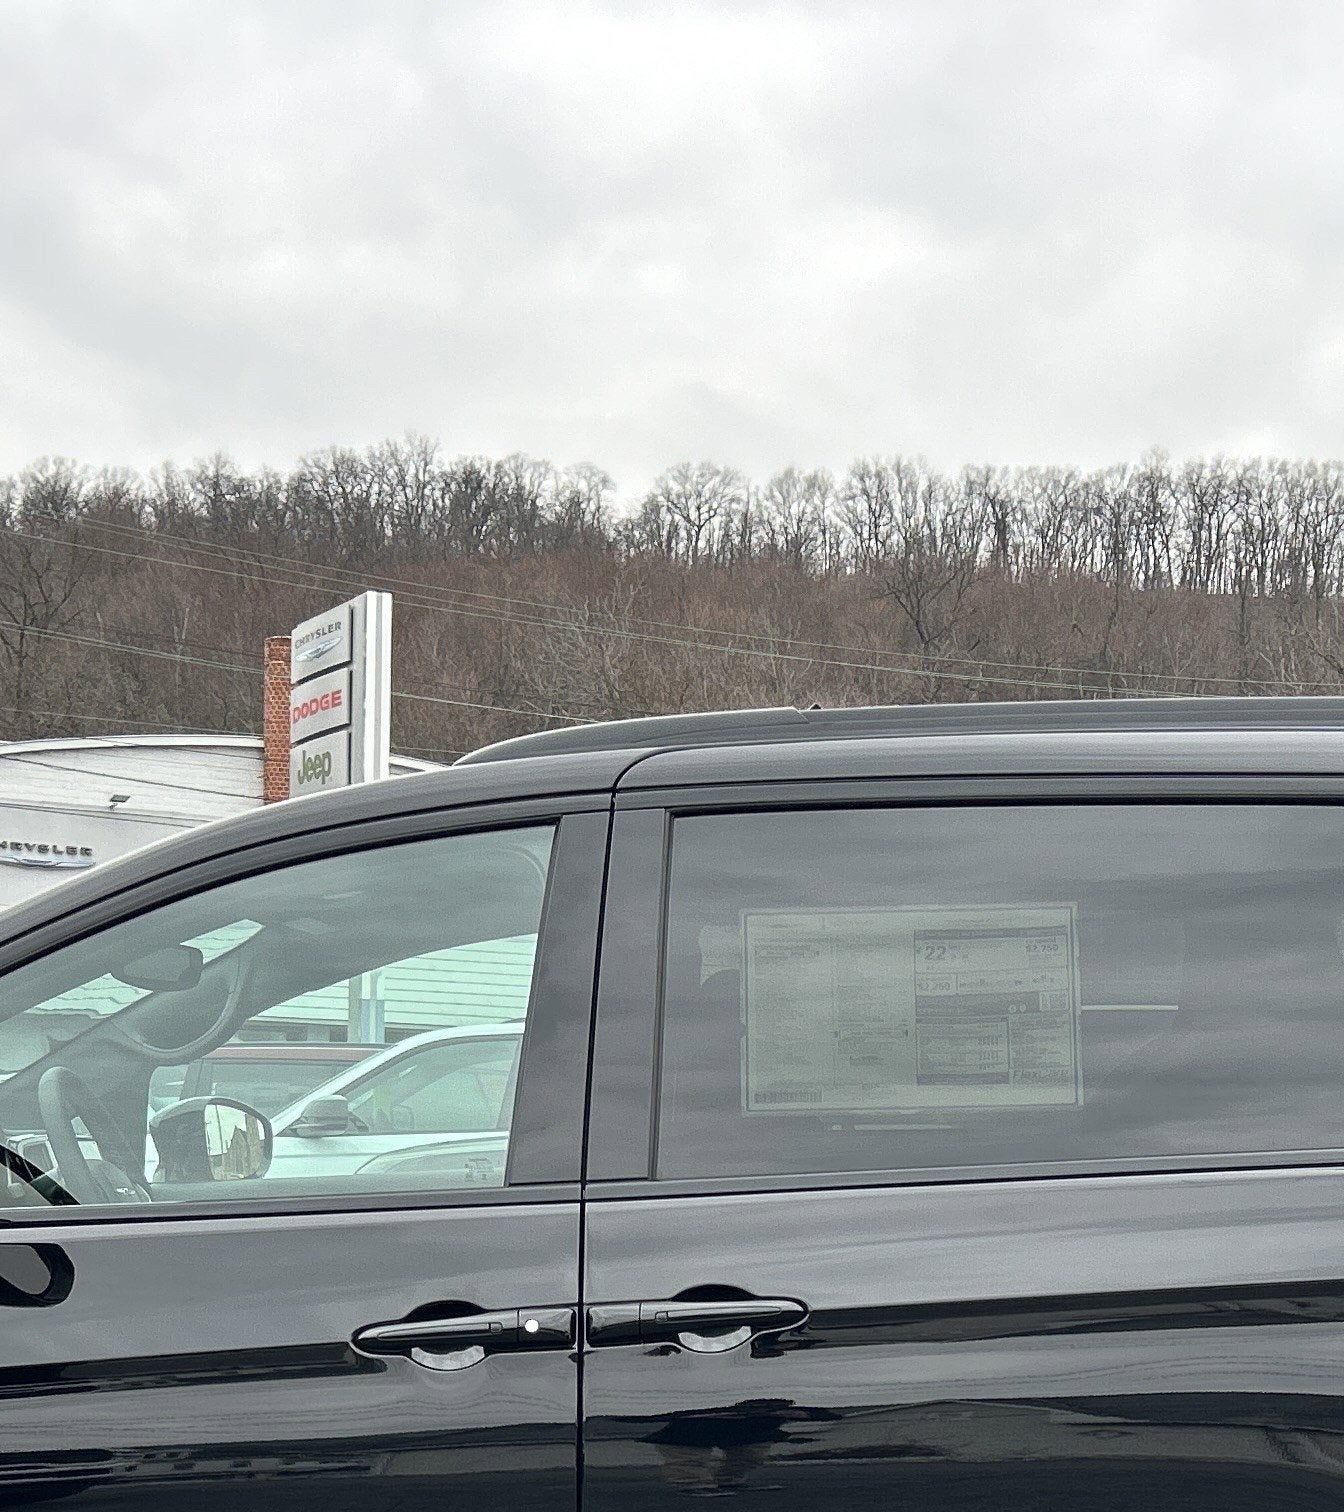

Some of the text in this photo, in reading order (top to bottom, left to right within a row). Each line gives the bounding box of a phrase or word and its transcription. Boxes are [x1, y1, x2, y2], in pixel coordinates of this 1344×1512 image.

[294, 621, 342, 649] CHRYSLER
[293, 689, 342, 724] DODGE
[297, 750, 331, 785] Jeep
[925, 945, 947, 960] 22
